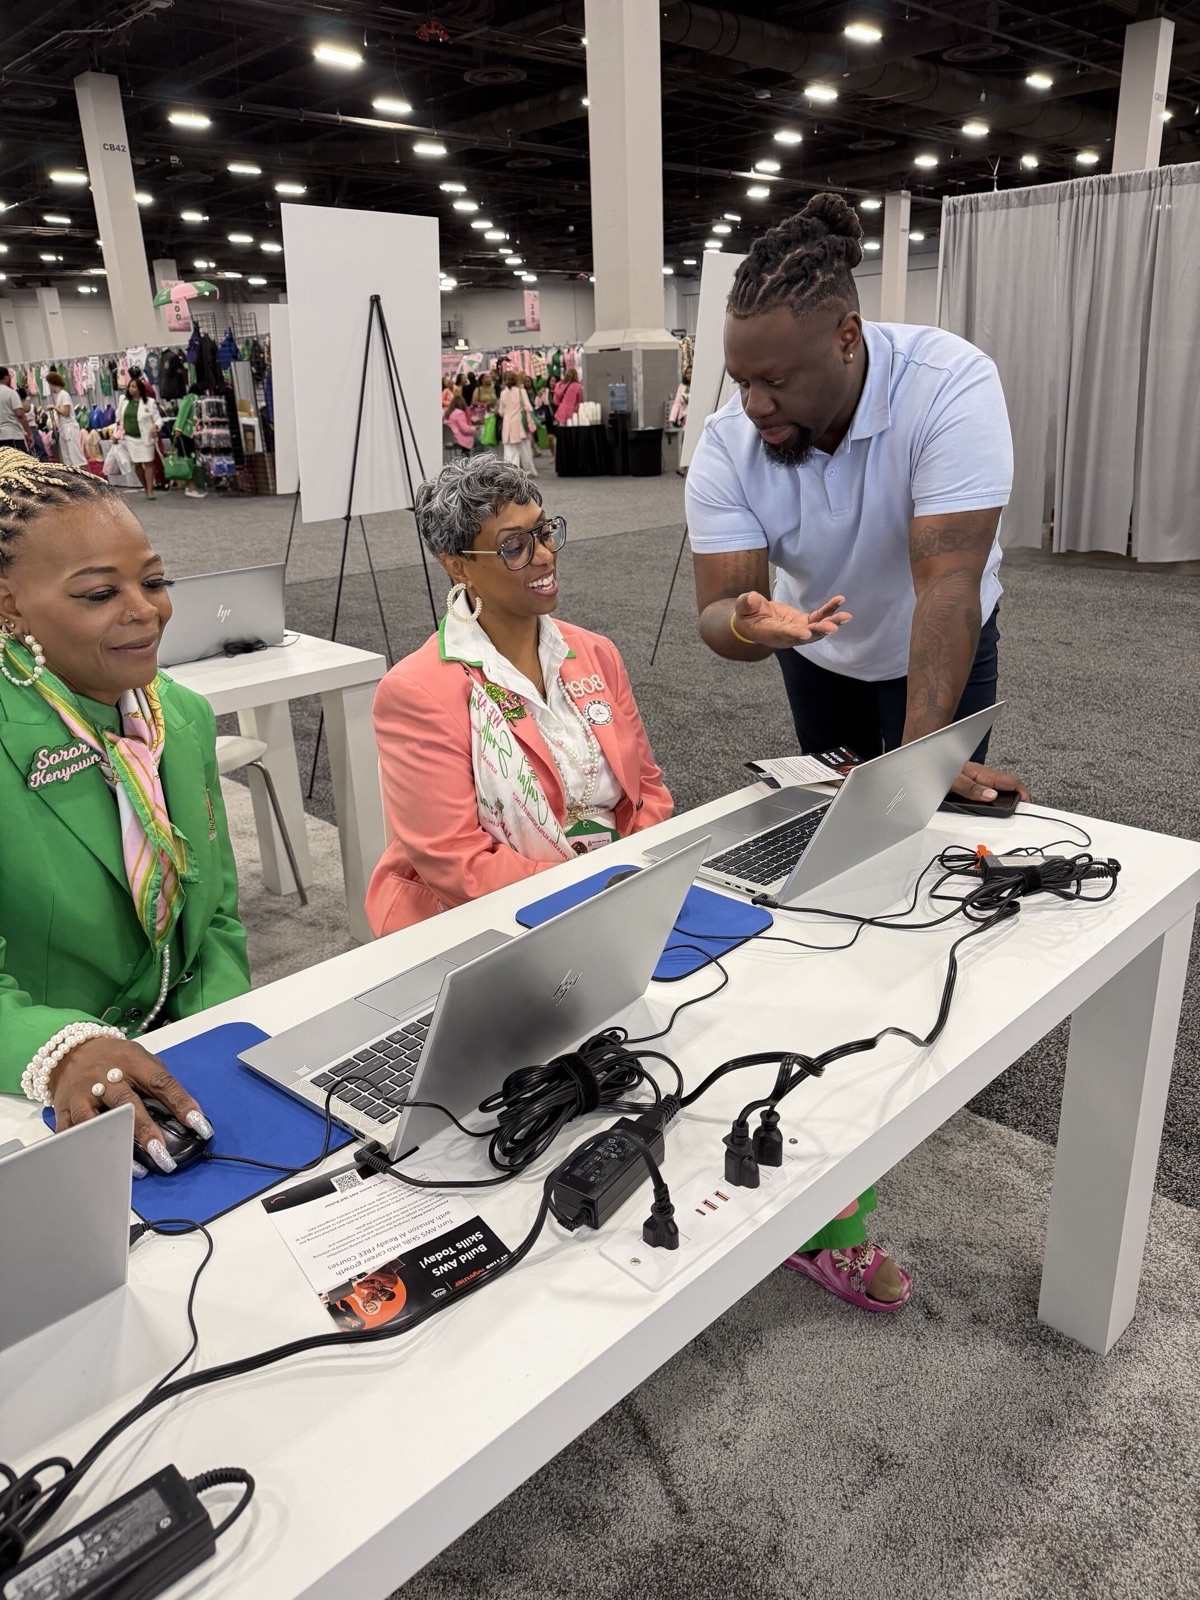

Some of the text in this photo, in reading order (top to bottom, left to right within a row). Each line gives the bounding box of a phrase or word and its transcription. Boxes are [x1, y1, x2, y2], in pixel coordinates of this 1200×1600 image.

[103, 143, 126, 152] CB42
[217, 604, 231, 623] hp
[565, 674, 605, 698] 1908
[37, 743, 90, 769] Soror
[29, 753, 102, 788] Kenyawn
[435, 1210, 452, 1221] with
[407, 1218, 436, 1235] Amazon
[335, 1218, 454, 1277] Turn AWS Skills into career growth
[375, 1235, 398, 1249] Ready
[418, 1230, 484, 1270] Skills Today!
[357, 1246, 376, 1258] FREE
[431, 1243, 488, 1278] Build AWS
[327, 1254, 357, 1271] Courses
